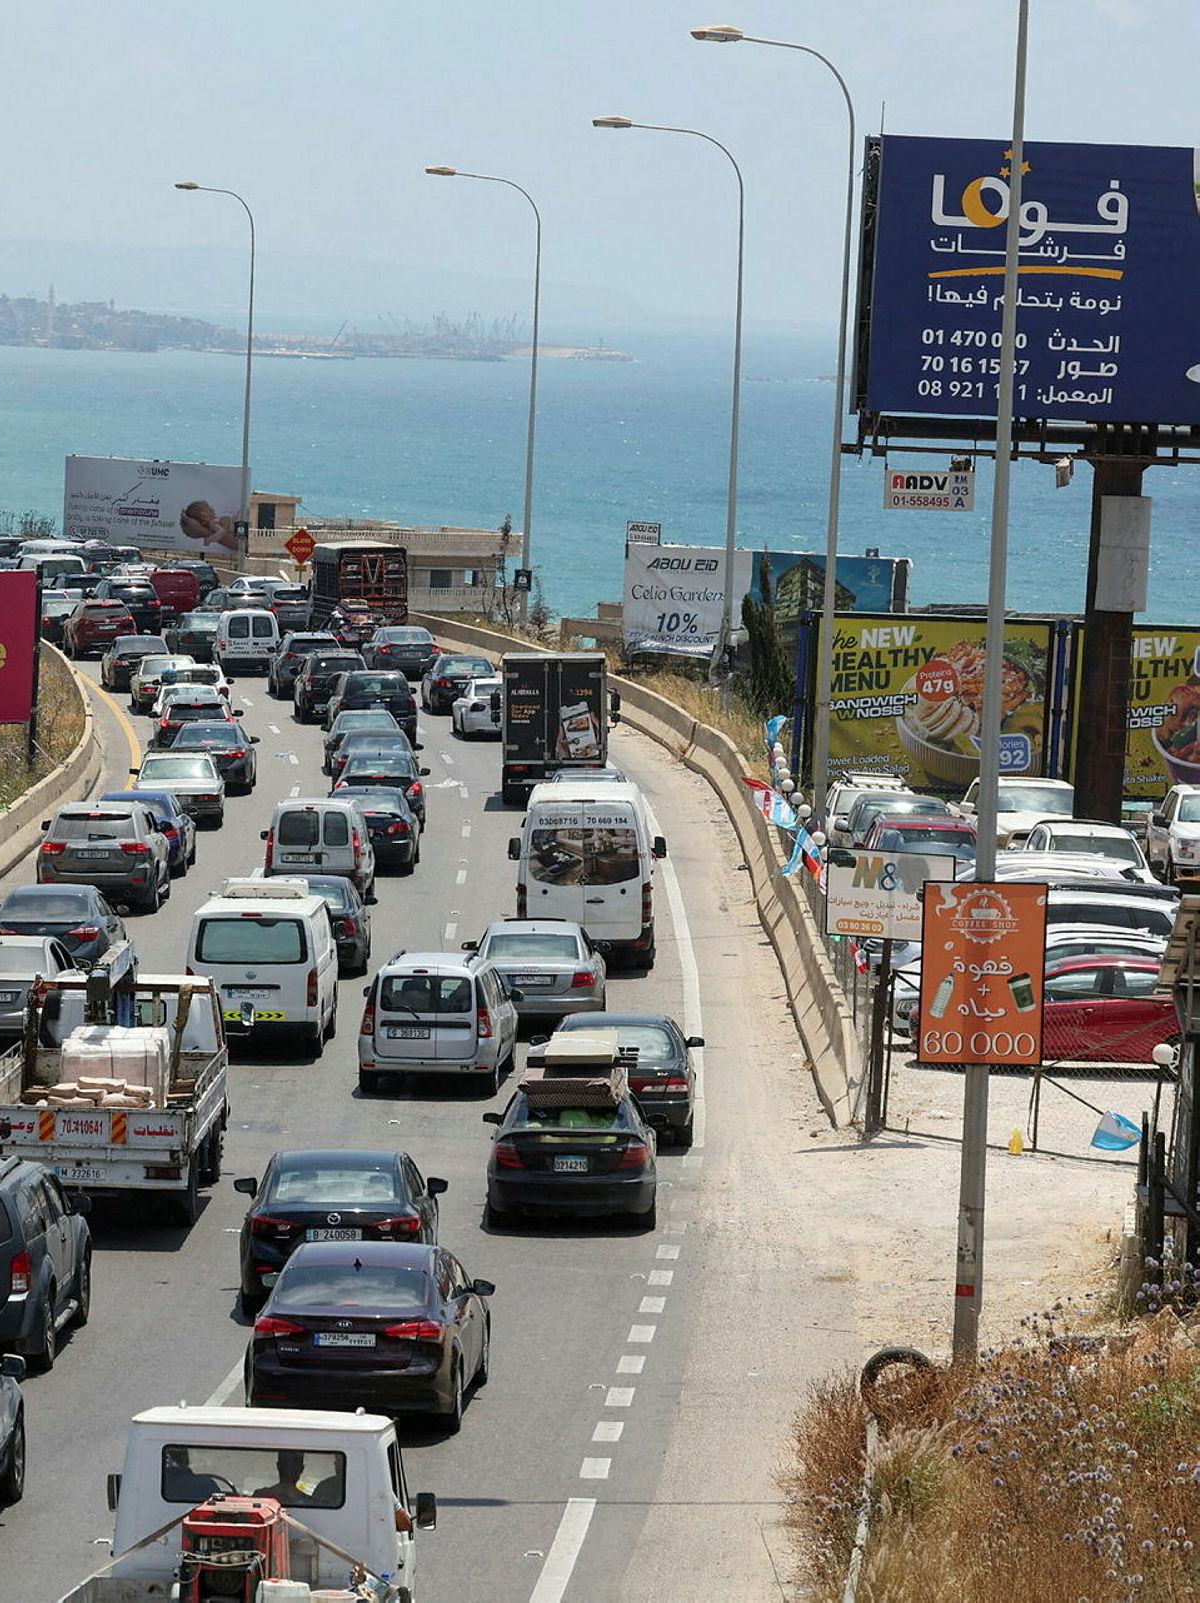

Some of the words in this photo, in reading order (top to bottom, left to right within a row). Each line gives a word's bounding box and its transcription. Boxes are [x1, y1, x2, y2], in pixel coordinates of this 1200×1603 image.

[1069, 290, 1122, 315] نومة
[921, 328, 945, 346] 01
[950, 330, 987, 348] 470
[990, 332, 1028, 350] 00
[1048, 327, 1121, 354] الحدث
[921, 354, 945, 373] 70
[950, 356, 973, 374] 16
[1056, 359, 1119, 381] صور
[917, 379, 942, 397] 08
[949, 380, 984, 398] 921
[952, 486, 970, 496] 03
[893, 495, 950, 507] 01-558495
[954, 497, 965, 508] A
[647, 557, 691, 570] ABOU
[694, 559, 719, 571] EID
[631, 584, 667, 600] Celia
[657, 612, 698, 634] 10%
[675, 634, 715, 644] DISCOUNT
[831, 628, 858, 650] he
[861, 626, 916, 650] NEW
[922, 679, 955, 694] 47g
[826, 757, 850, 768] ower
[853, 753, 890, 765] Loaded
[883, 763, 911, 774] Salad
[951, 919, 986, 929] COFFEE
[992, 920, 1018, 929] SHOP
[952, 956, 1014, 982] قهوة
[956, 998, 1007, 1022] مياه
[923, 1031, 963, 1056] 60
[970, 1031, 1036, 1058] 000
